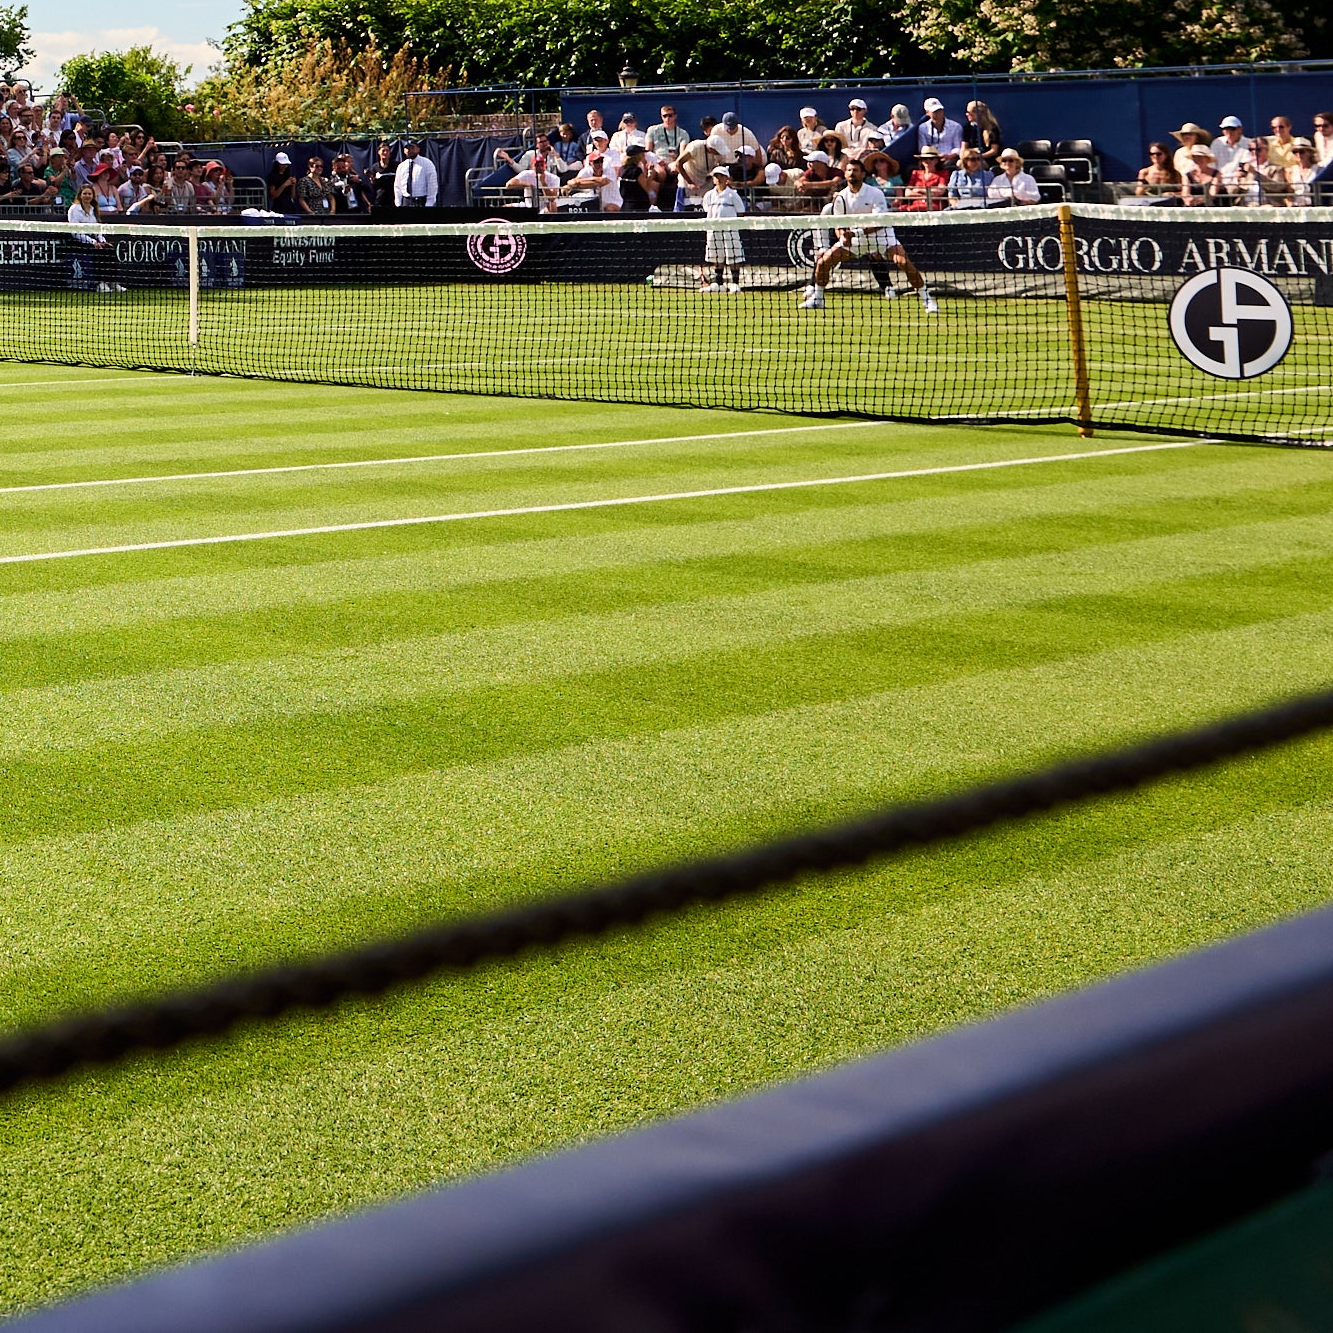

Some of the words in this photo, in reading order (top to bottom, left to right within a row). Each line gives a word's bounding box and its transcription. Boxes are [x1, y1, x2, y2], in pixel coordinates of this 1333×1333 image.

[115, 240, 183, 263] GIORGIO
[198, 239, 247, 260] RMANI
[273, 249, 306, 266] Equity
[309, 249, 335, 263] Fund
[997, 235, 1163, 273] GIORGIO
[1178, 237, 1333, 275] ARMAN
